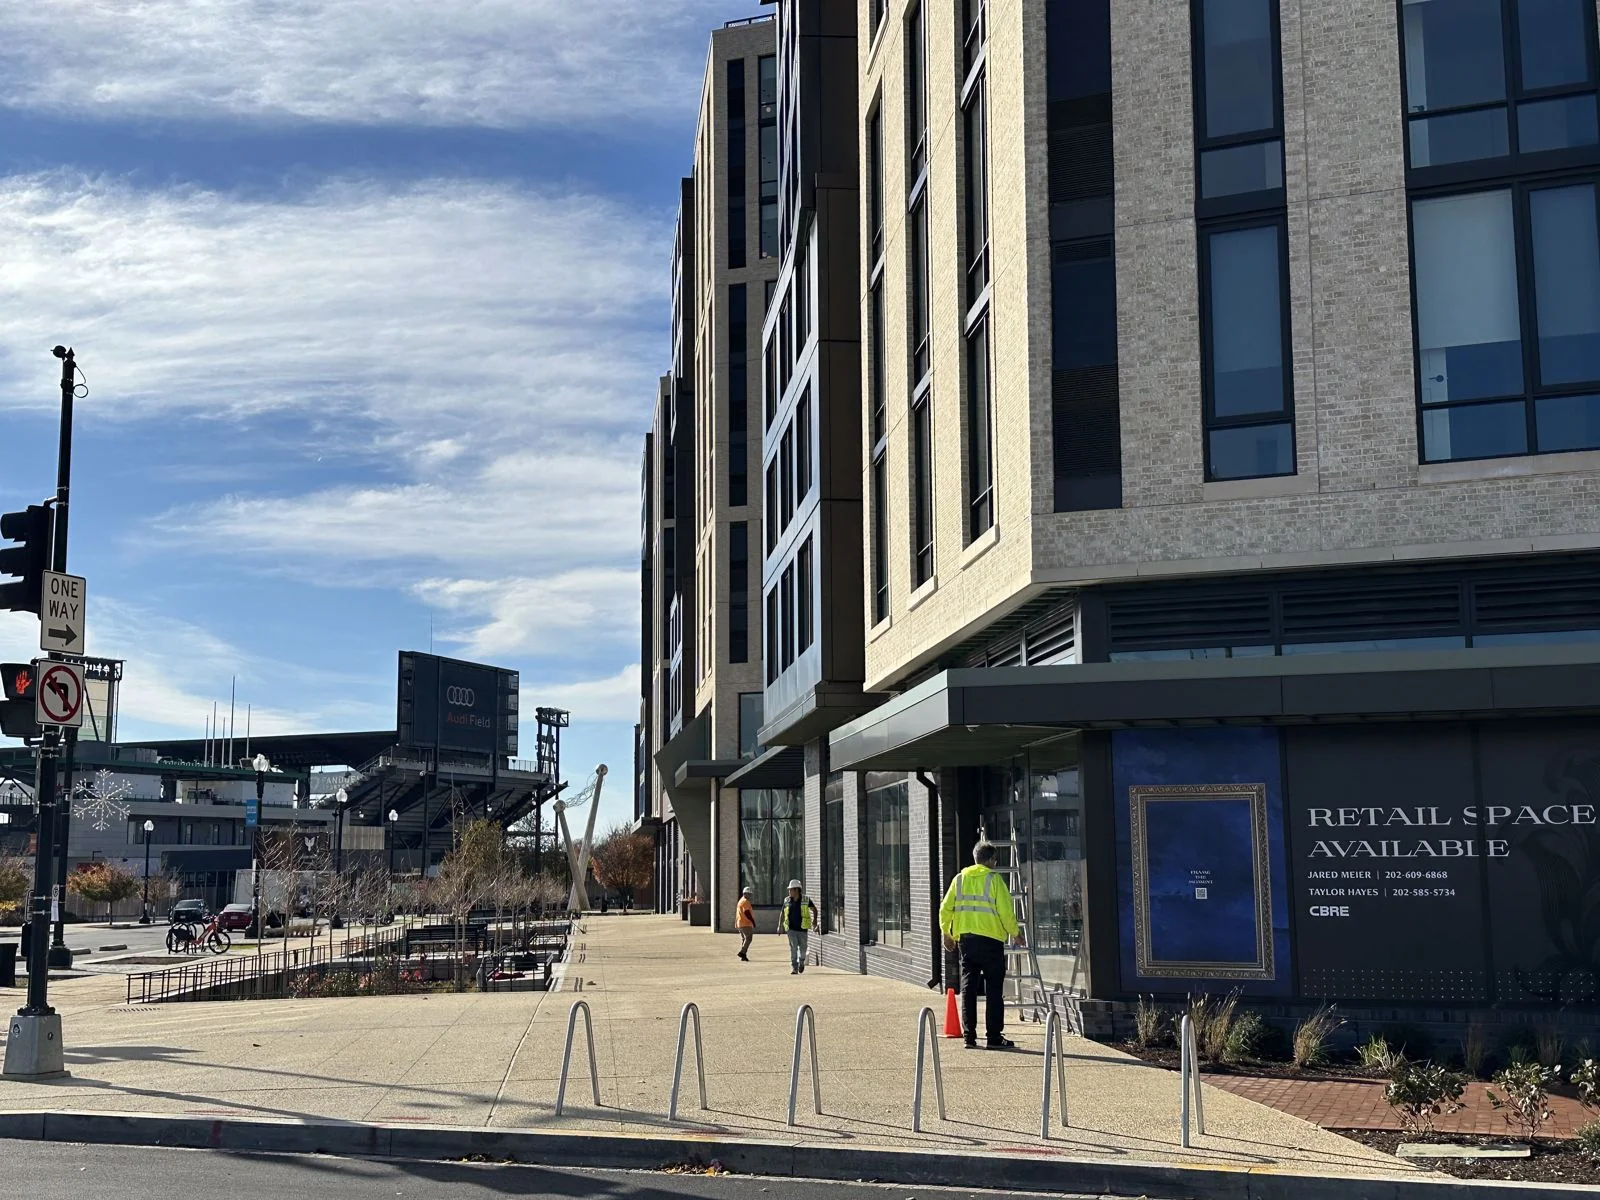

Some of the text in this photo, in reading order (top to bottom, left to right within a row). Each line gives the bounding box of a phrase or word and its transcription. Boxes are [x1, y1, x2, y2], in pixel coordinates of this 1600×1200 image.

[51, 578, 78, 598] ONE
[49, 600, 78, 620] WAY
[447, 712, 491, 728] Audi Field
[1307, 804, 1597, 827] RETAIL SPACE
[1307, 839, 1510, 858] AVAILABLE
[1307, 870, 1448, 879] JARED MEIER 202-609-6868
[1308, 888, 1456, 897] TAYLOR HAYES 202-585-5734
[1309, 905, 1350, 917] CBRE
